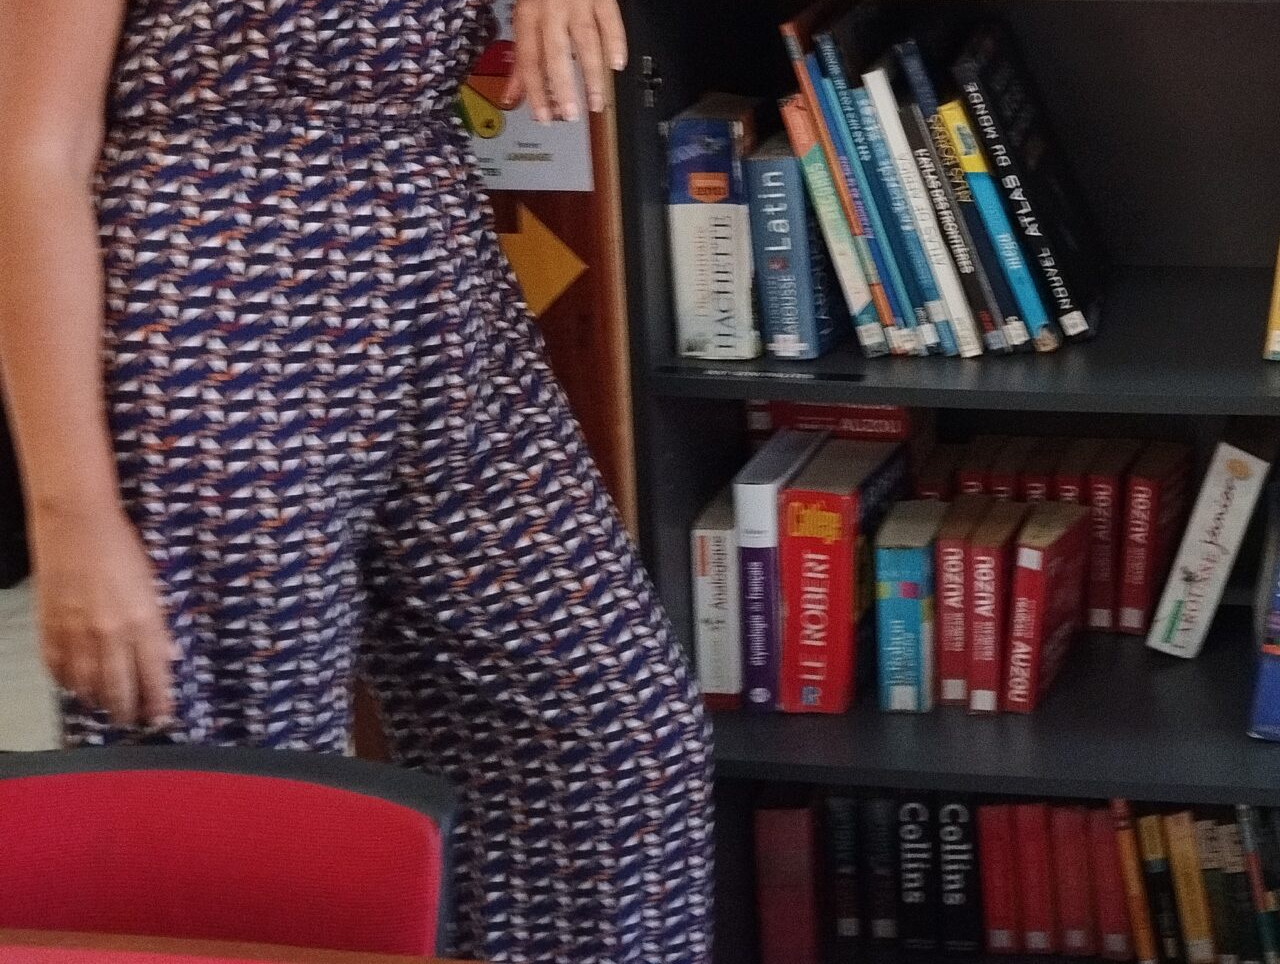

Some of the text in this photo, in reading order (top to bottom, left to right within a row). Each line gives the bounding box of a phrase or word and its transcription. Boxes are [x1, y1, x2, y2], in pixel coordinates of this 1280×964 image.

[762, 168, 791, 253] Latin
[963, 81, 1073, 311] NOUVEL ATLAS DU MONDE
[920, 224, 946, 269] ATLAS
[779, 275, 802, 339] AROUSSE
[1091, 483, 1114, 540] AUZOU
[1130, 485, 1153, 543] AUZOU
[708, 534, 728, 609] Analogique
[943, 547, 964, 608] AUZOU
[976, 555, 995, 616] AUZOU
[796, 551, 831, 681] LE ROBERT
[1006, 640, 1032, 702] AUZOU
[899, 801, 932, 904] Collins
[938, 803, 974, 906] Collins
